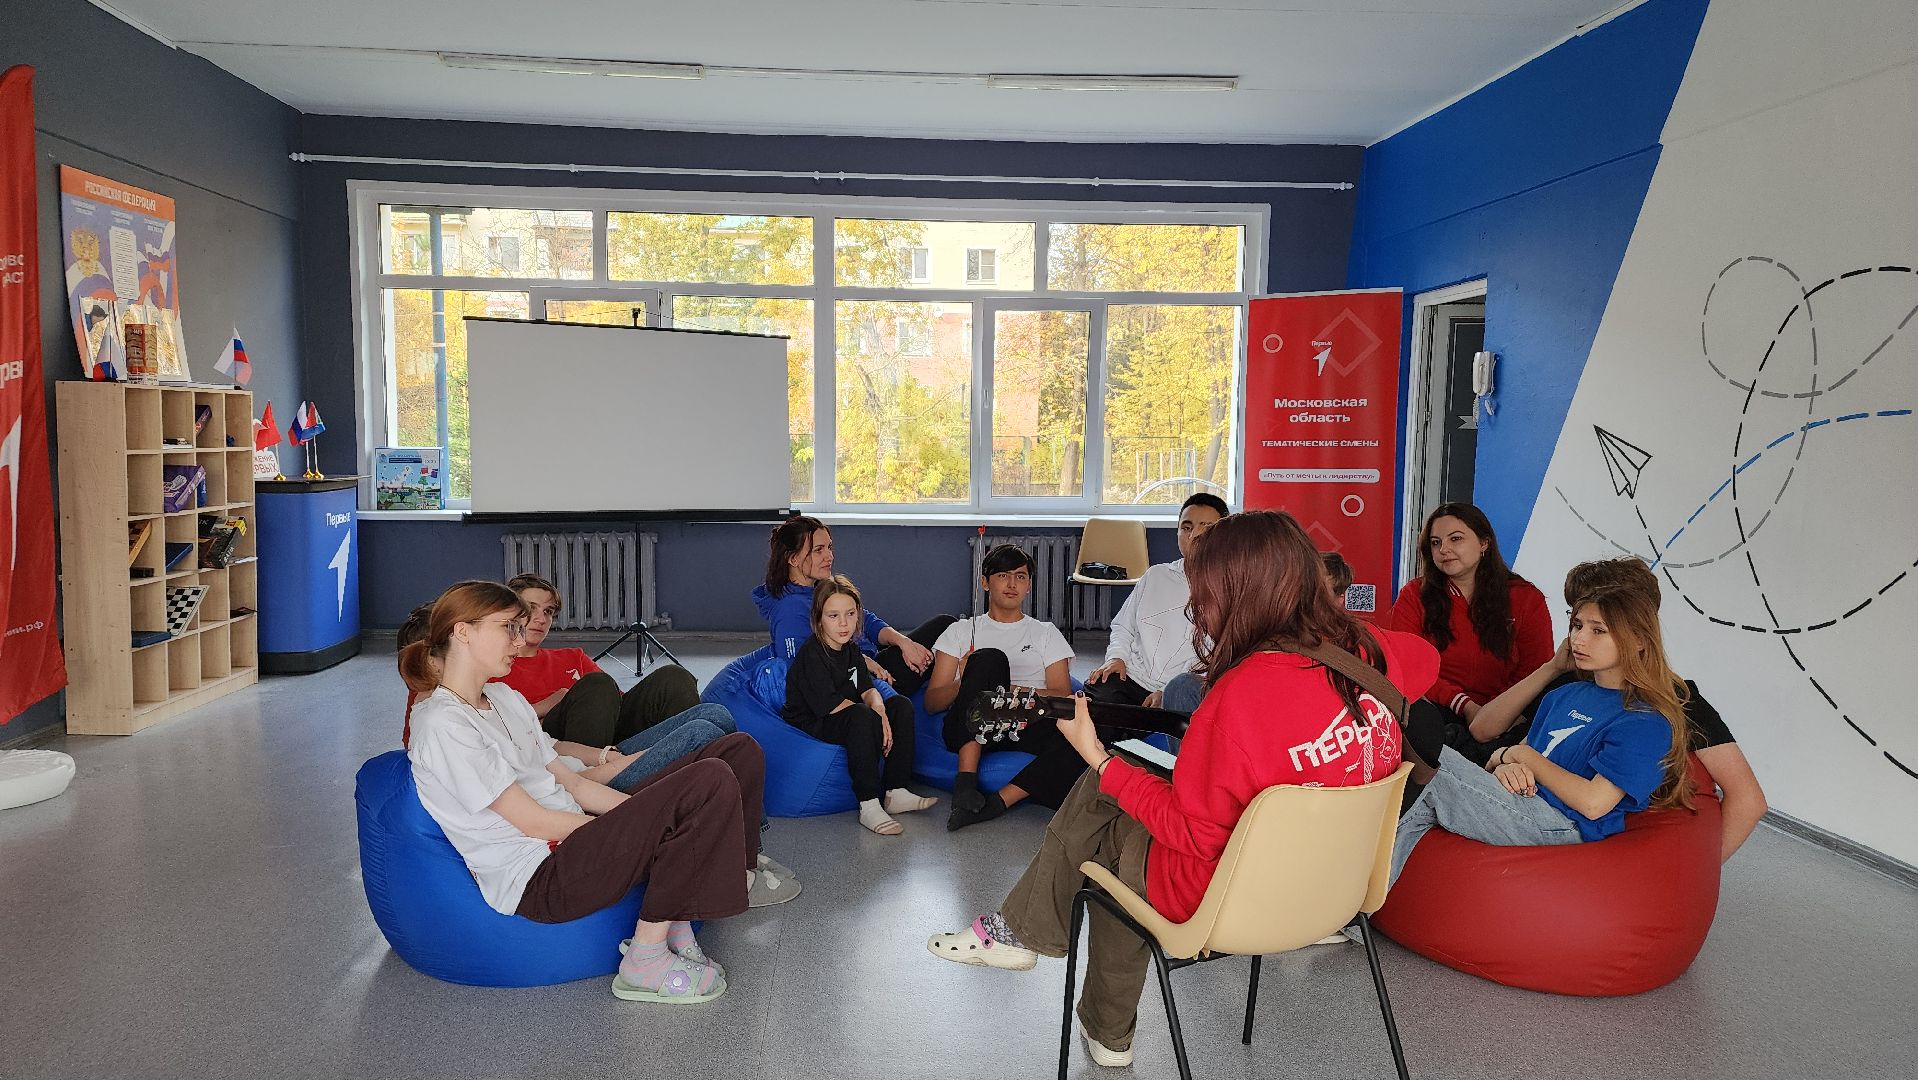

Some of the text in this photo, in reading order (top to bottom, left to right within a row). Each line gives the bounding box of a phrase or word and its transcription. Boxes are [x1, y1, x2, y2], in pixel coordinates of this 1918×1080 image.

[122, 192, 156, 212] ФЕДЕРАЦИЯ
[1274, 398, 1368, 409] Московская
[1289, 411, 1351, 423] область
[1340, 439, 1379, 447] СМЕНЫ
